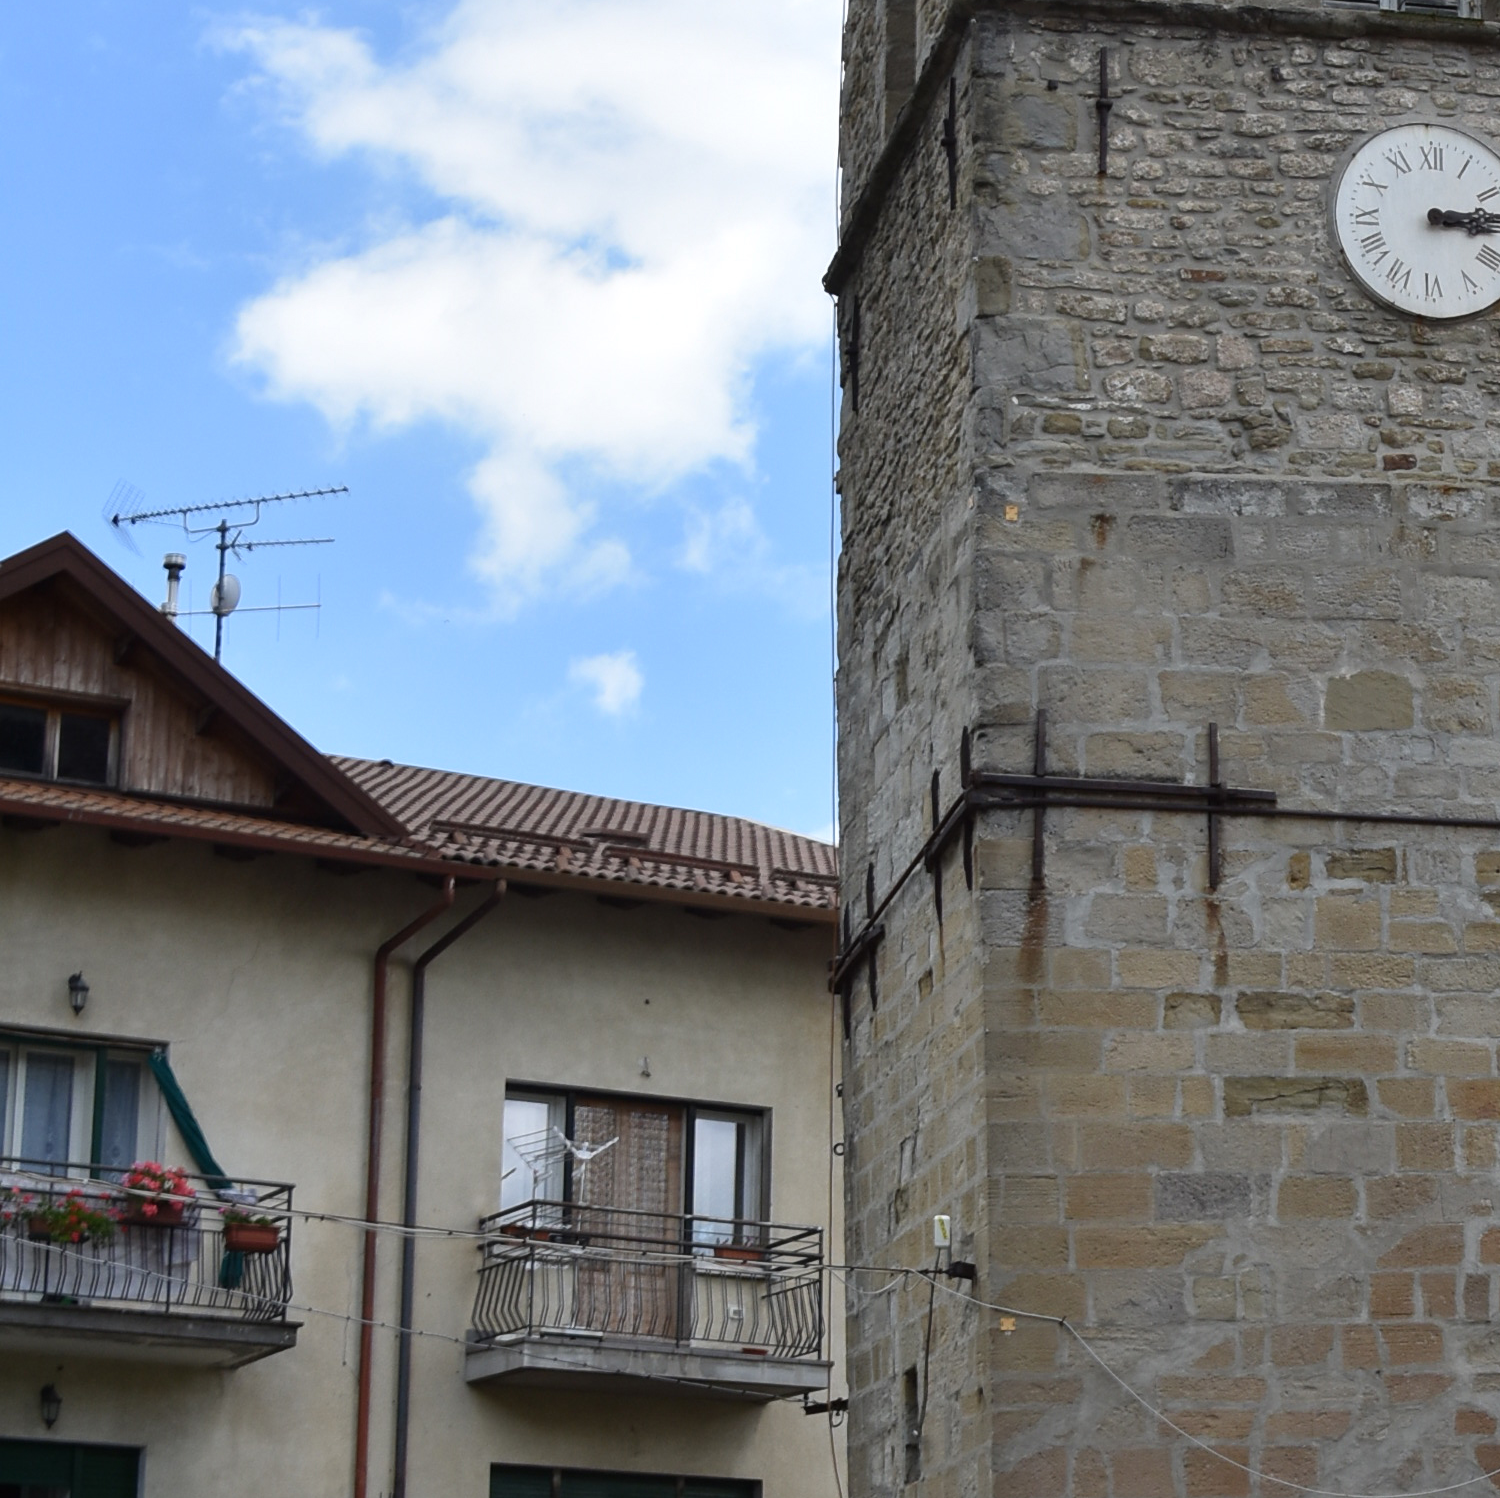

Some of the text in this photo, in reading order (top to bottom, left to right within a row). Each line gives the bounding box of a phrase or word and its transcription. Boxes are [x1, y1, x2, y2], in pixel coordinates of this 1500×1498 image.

[1386, 150, 1412, 178] XI
[1420, 146, 1443, 171] XII
[1457, 159, 1470, 179] I
[1362, 174, 1388, 196] X
[1476, 186, 1500, 202] II
[1356, 206, 1379, 226] IX
[1361, 231, 1391, 266] VIII
[1386, 258, 1412, 289] VII
[1425, 273, 1443, 297] VI
[1461, 270, 1478, 292] V
